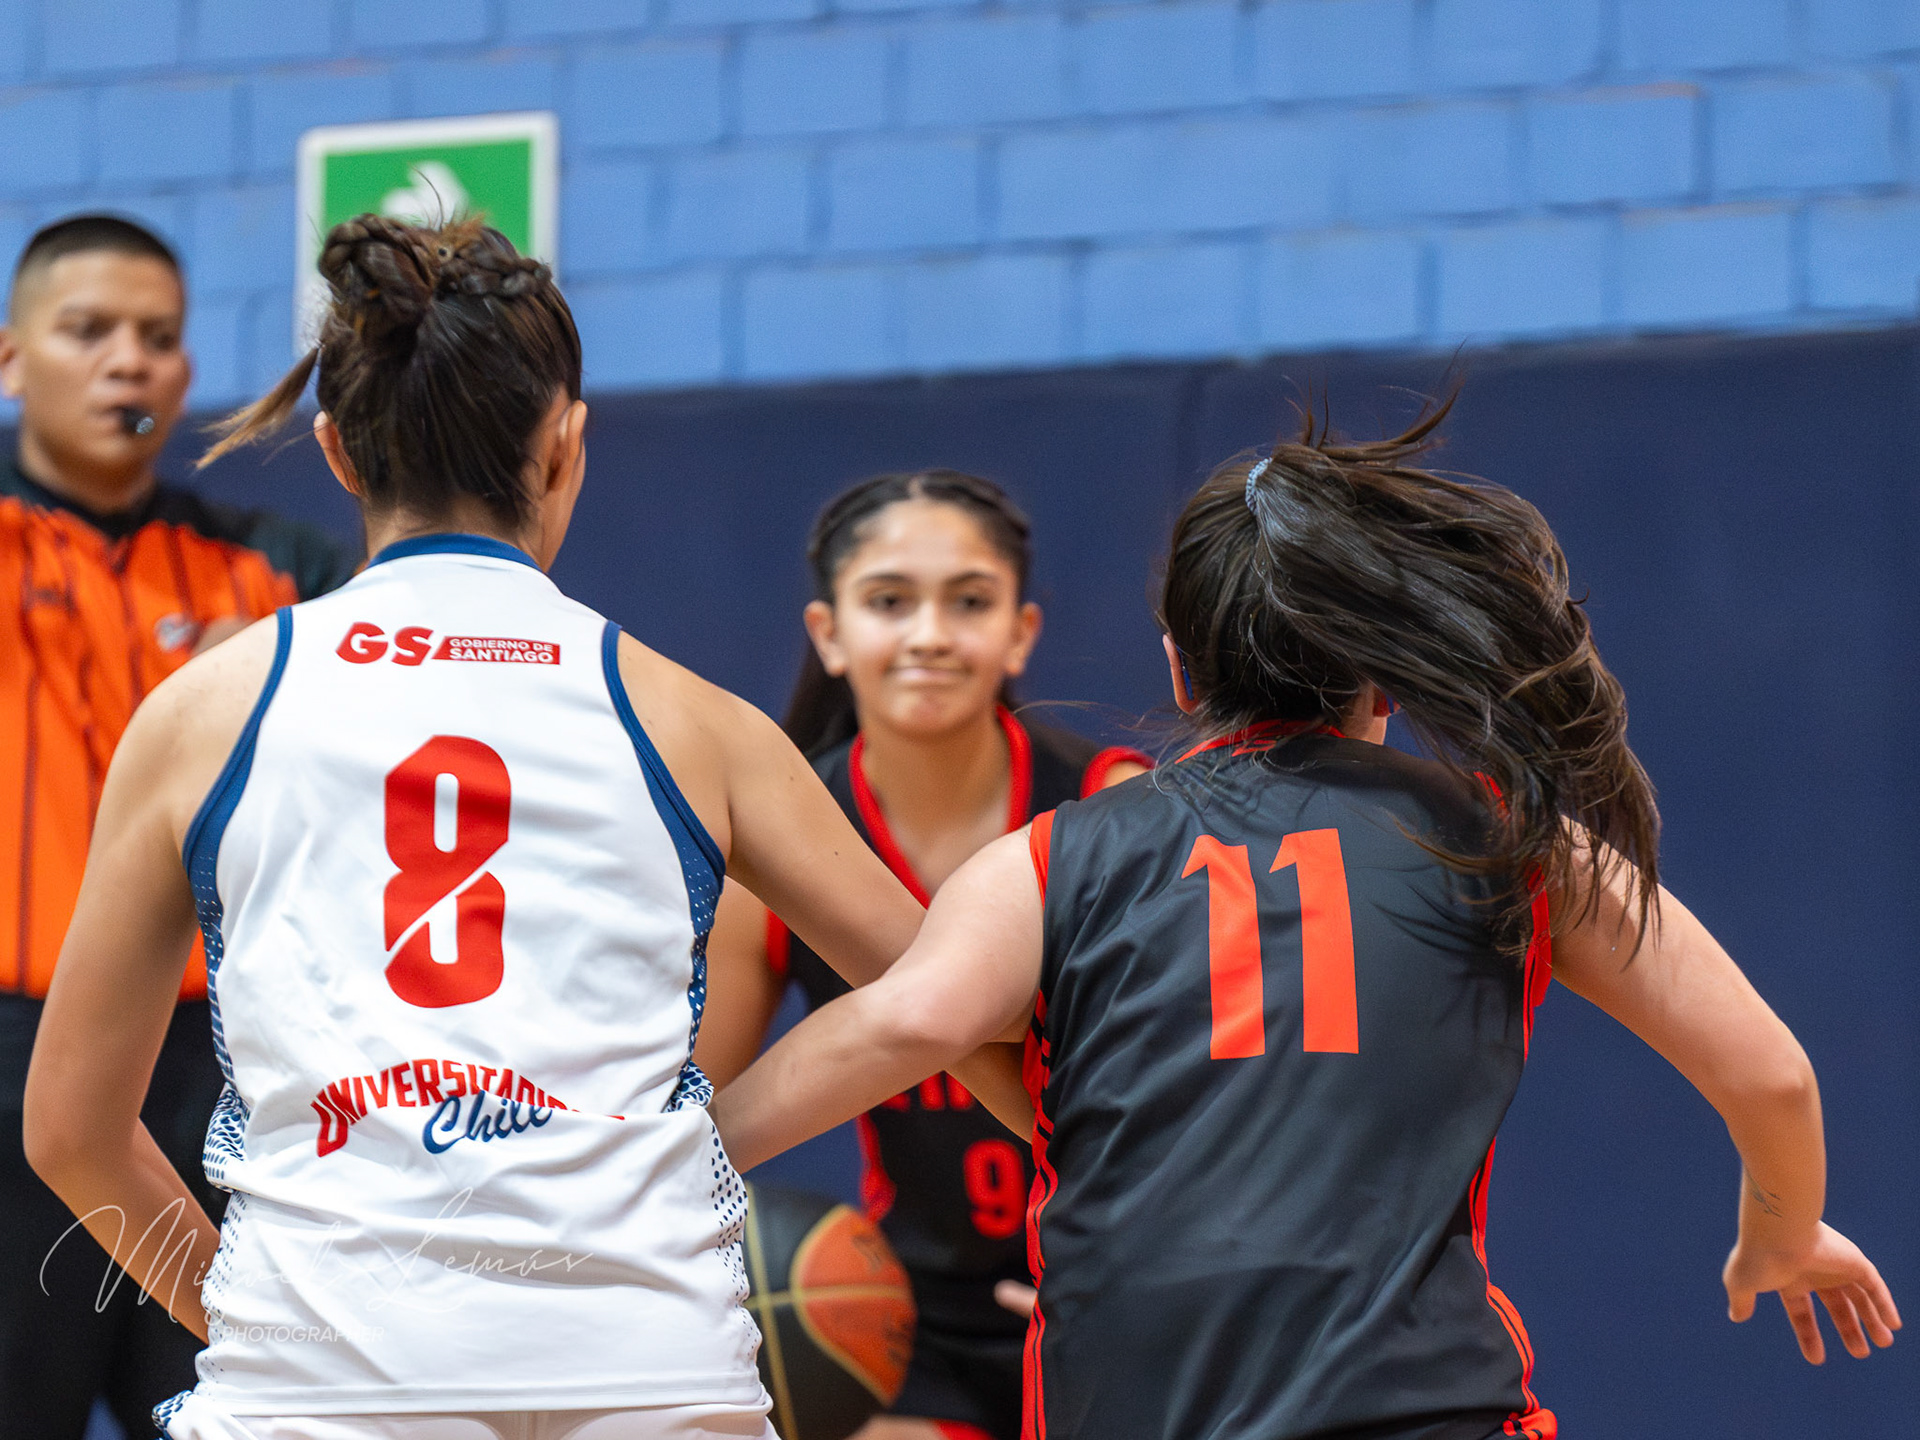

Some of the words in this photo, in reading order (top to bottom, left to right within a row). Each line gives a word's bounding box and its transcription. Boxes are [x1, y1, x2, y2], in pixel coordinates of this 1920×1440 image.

[335, 622, 434, 666] GS
[449, 638, 530, 651] GOBIERNO
[532, 643, 553, 652] DE
[449, 648, 554, 663] SANTIAGO
[384, 734, 512, 1009] 8
[1181, 828, 1360, 1061] 11
[962, 1138, 1027, 1240] 9
